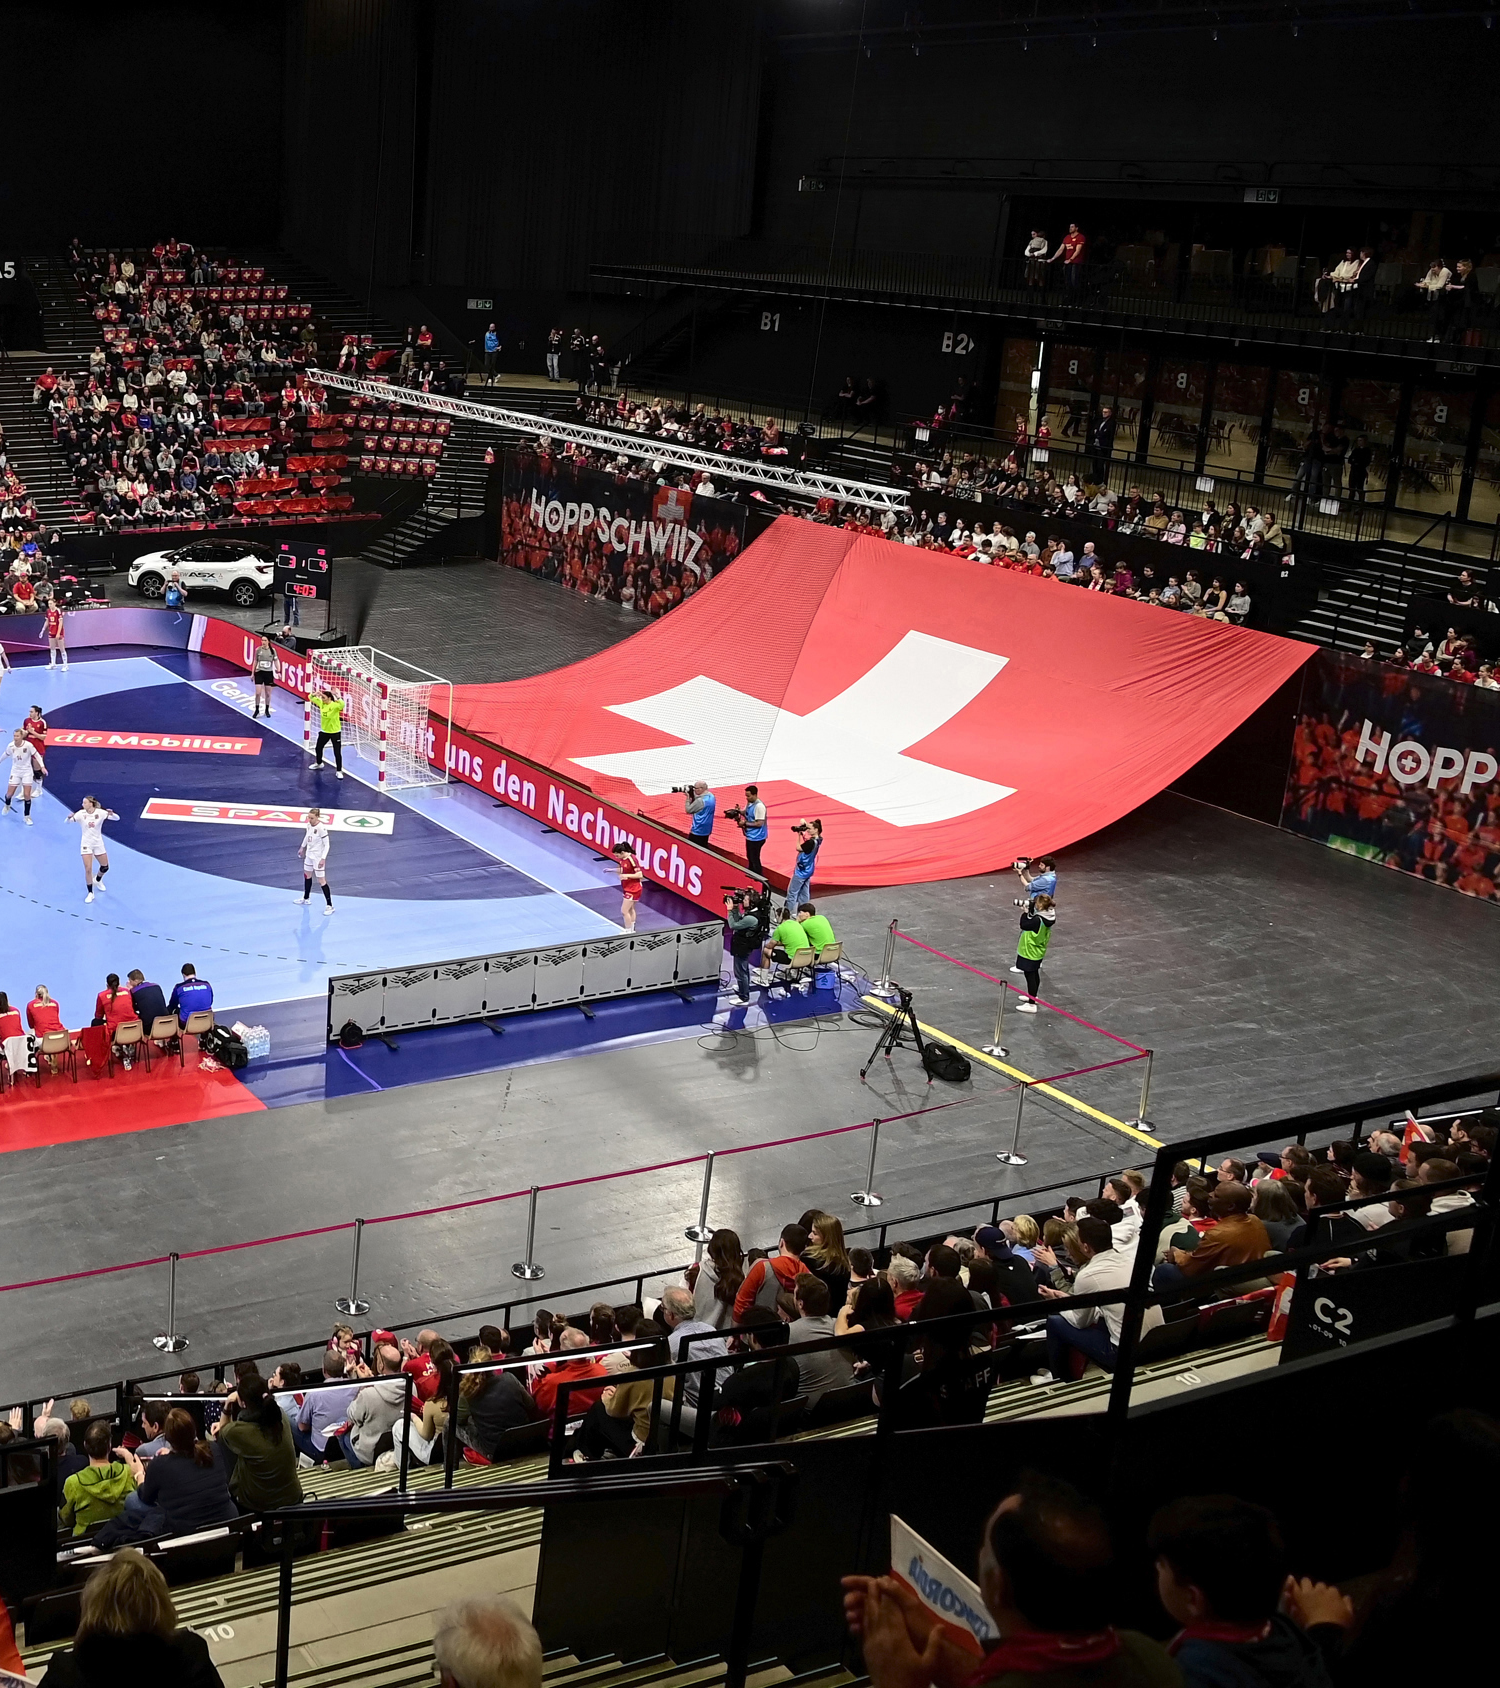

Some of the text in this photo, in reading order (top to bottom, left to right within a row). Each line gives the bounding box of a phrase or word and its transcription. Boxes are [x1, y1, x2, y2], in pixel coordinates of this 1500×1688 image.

[760, 312, 780, 331] B1
[942, 332, 968, 354] B2
[530, 487, 704, 582] HOPP SCHWIIZ
[289, 556, 296, 567] 3
[319, 561, 326, 570] 4
[293, 584, 316, 597] 4:03
[54, 733, 248, 751] die Mobiliar
[1355, 718, 1498, 794] HOPP
[444, 742, 483, 783] uns
[492, 760, 536, 810] den
[191, 806, 331, 825] SPAR
[1314, 1297, 1353, 1335] C2
[1175, 1373, 1201, 1387] 10
[204, 1623, 235, 1642] 10
